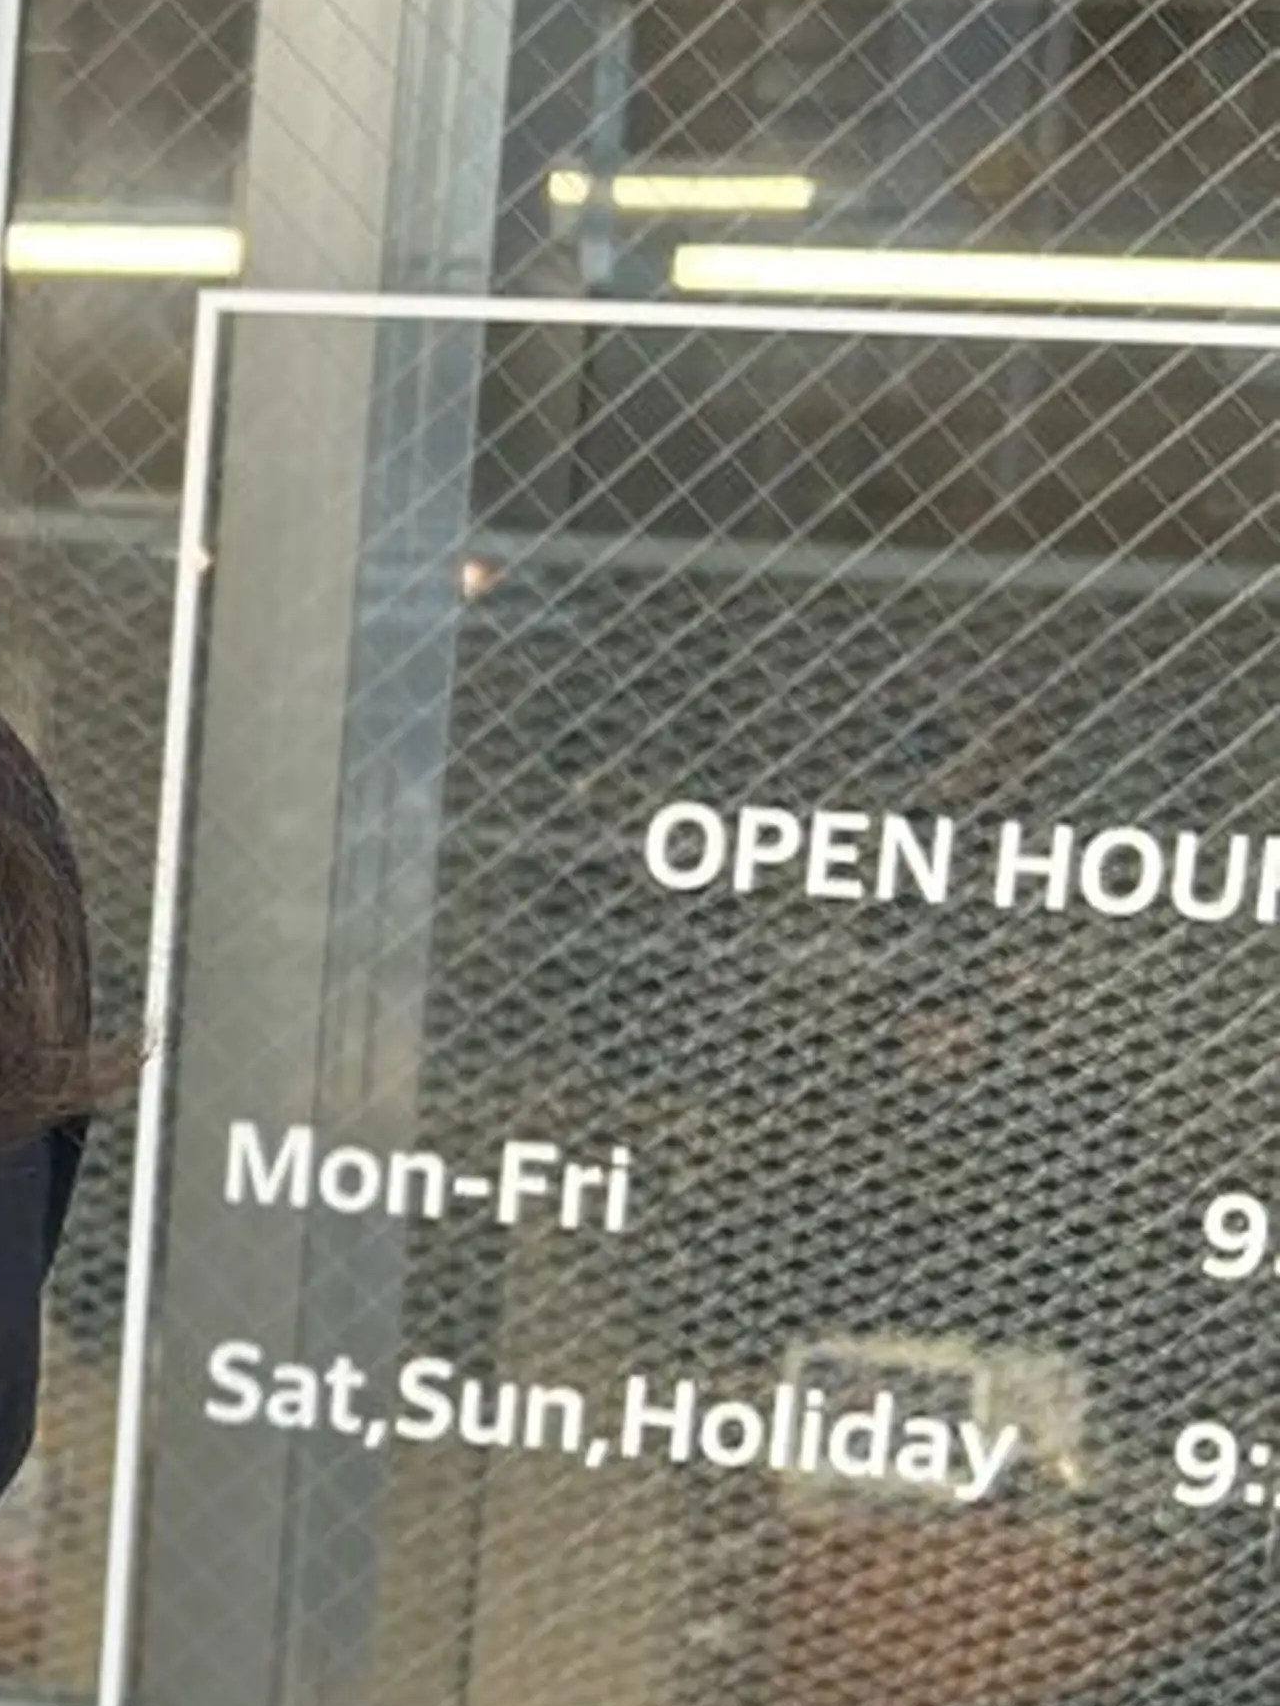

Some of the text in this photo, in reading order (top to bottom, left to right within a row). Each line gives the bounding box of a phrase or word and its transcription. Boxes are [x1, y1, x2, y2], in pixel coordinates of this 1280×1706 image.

[644, 801, 954, 905] OPEN
[225, 1121, 632, 1233] Mon-Fri
[204, 1341, 1280, 1509] Sat,Sun,Holiday 9:
